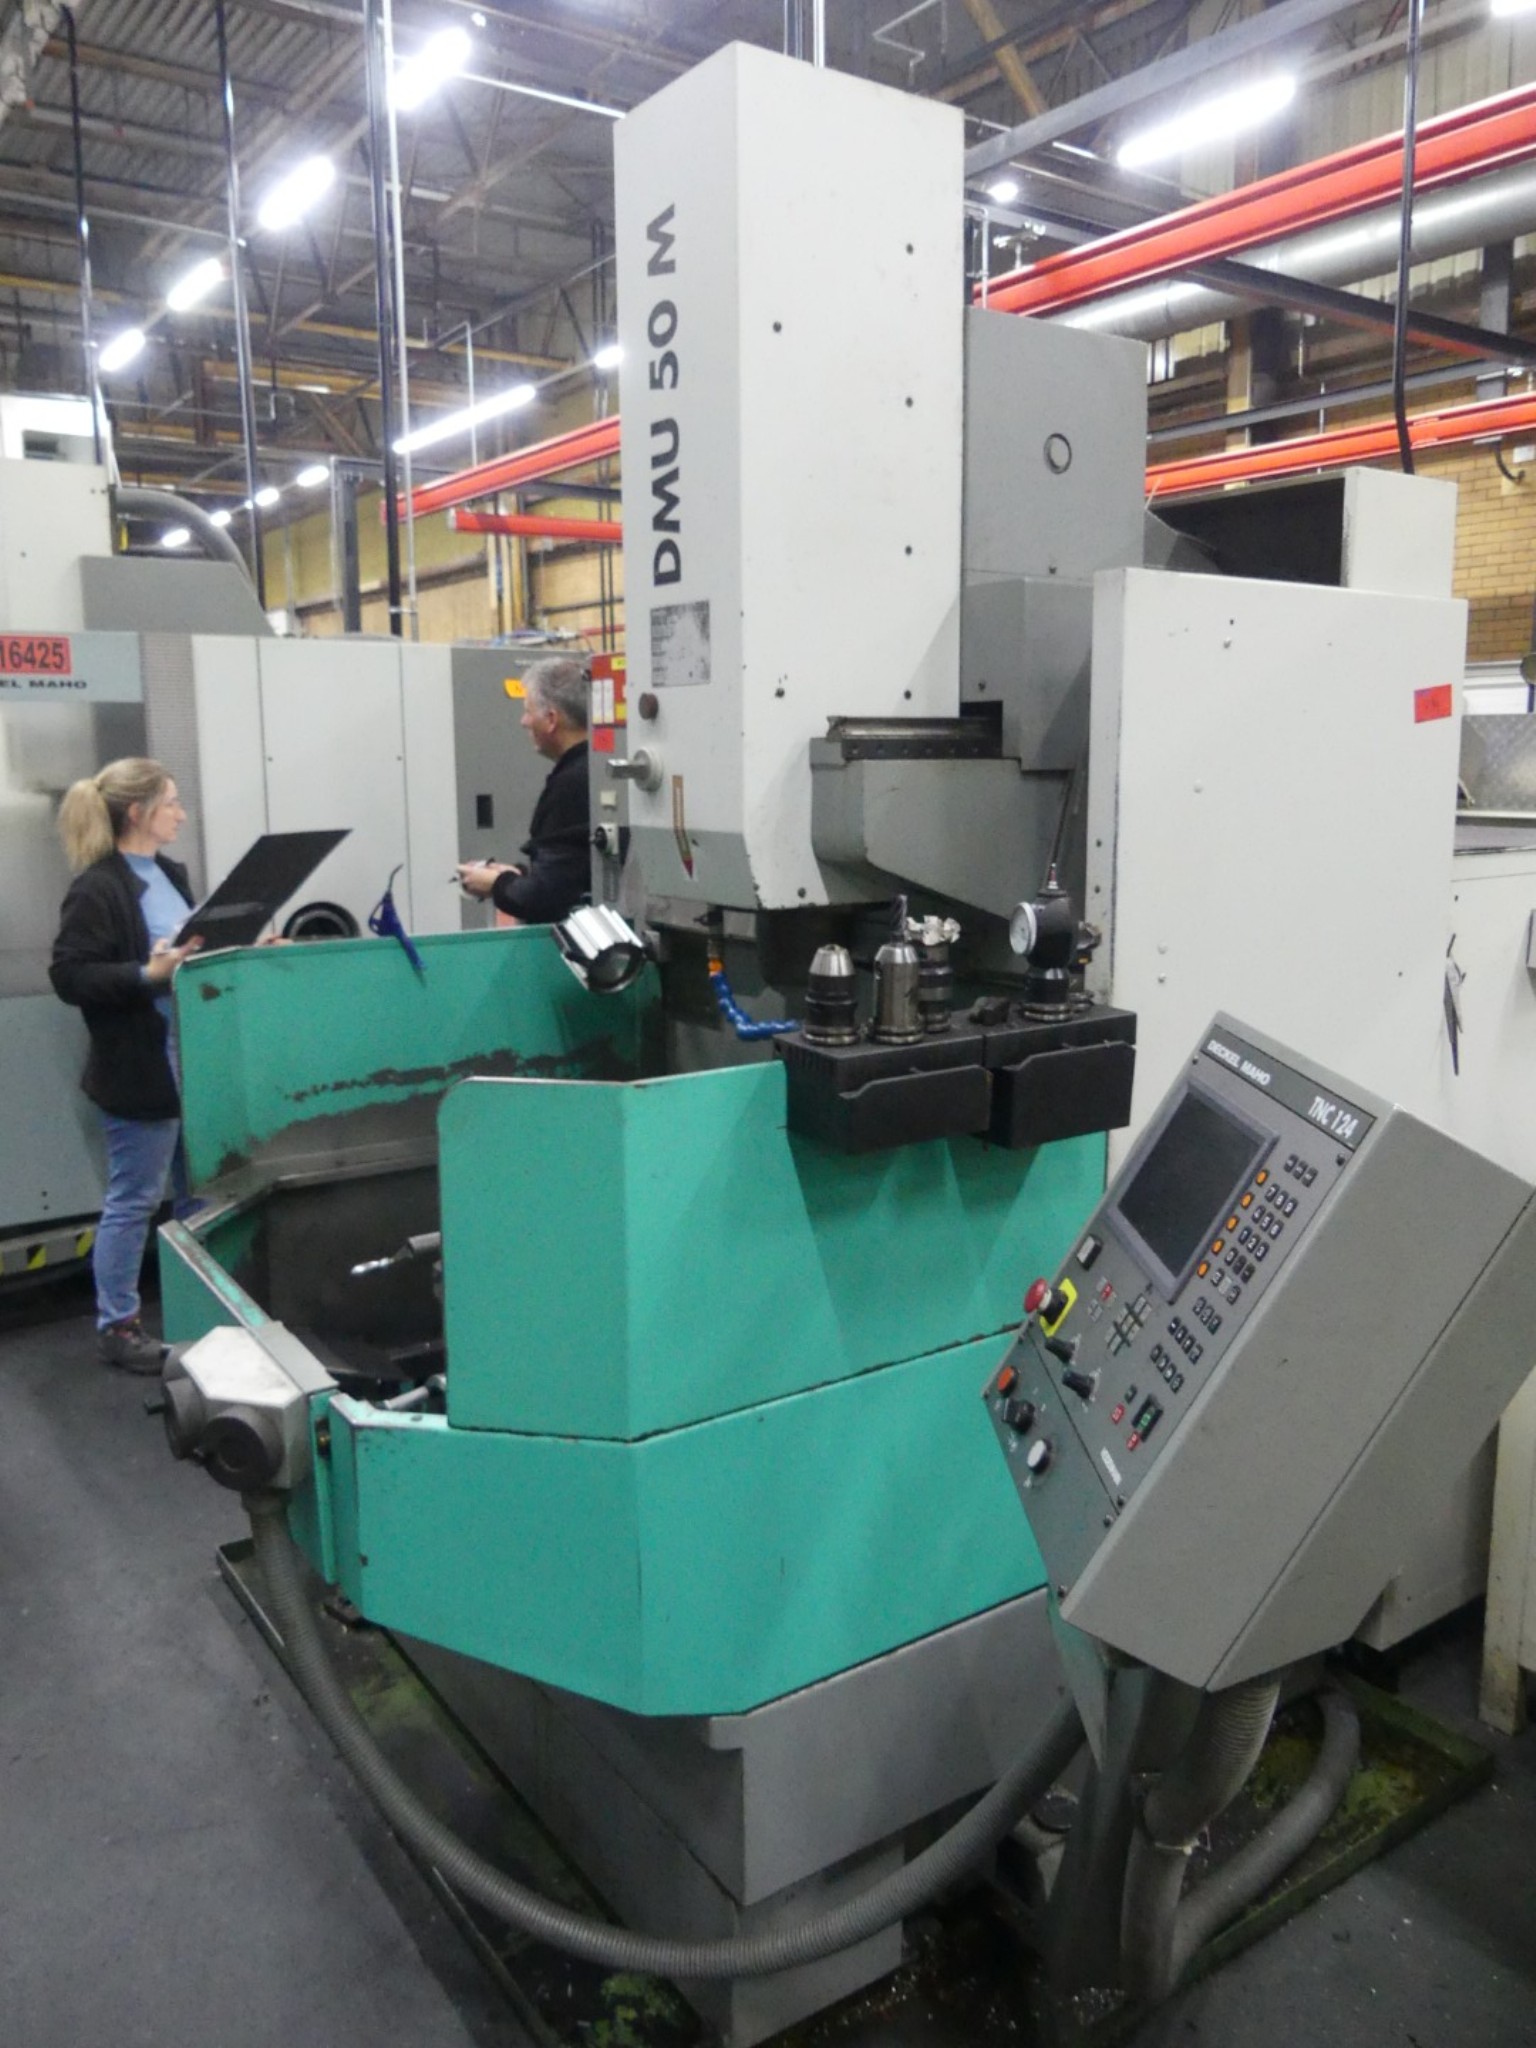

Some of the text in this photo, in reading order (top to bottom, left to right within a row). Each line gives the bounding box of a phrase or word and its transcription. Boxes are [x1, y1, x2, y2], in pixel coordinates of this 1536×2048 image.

[646, 203, 676, 277] M
[647, 299, 679, 390] 50
[651, 418, 681, 587] DMU
[0, 640, 64, 668] 16425
[29, 681, 87, 689] MAHO
[1206, 1039, 1271, 1086] DECKEL MAHO
[1308, 1095, 1358, 1139] TNC 124
